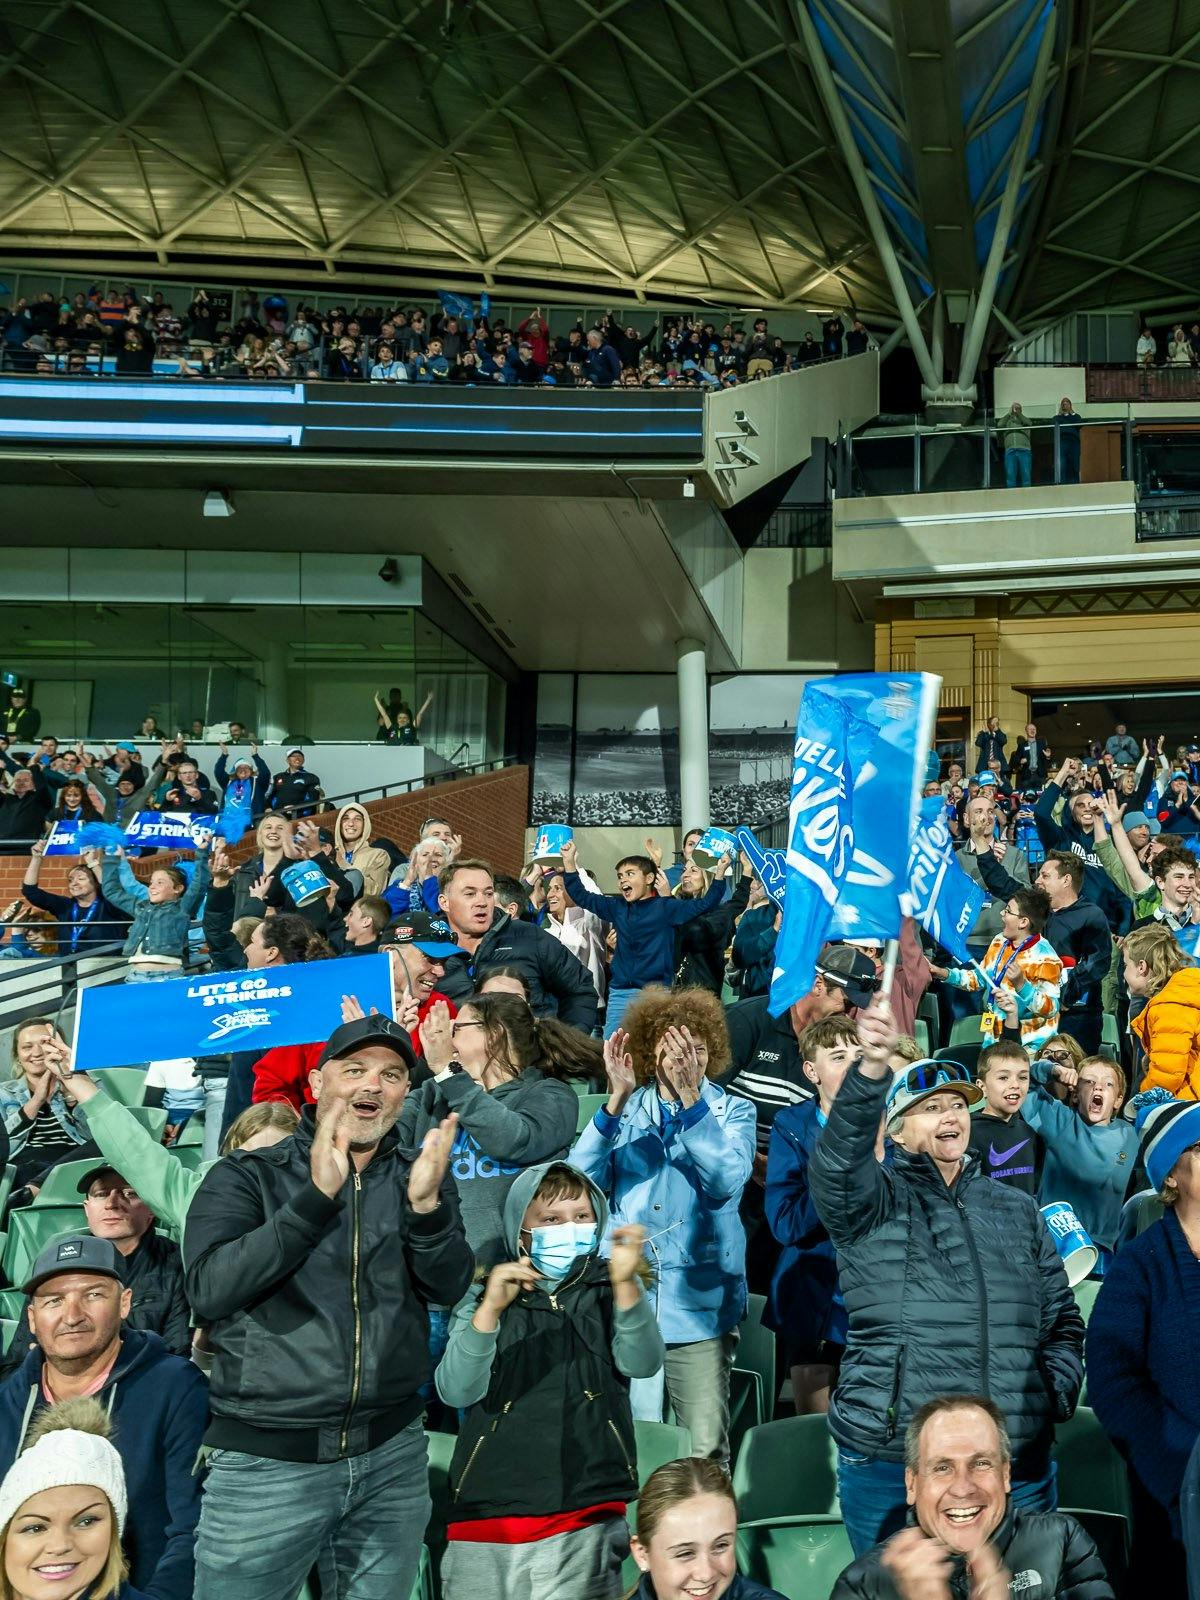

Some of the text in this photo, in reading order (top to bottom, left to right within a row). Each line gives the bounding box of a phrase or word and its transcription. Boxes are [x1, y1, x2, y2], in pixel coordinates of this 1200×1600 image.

[187, 978, 268, 998] LET'S GO
[202, 986, 292, 1007] STRIKERS
[1014, 1570, 1028, 1579] THE
[1006, 1577, 1030, 1590] NORTH
[1013, 1582, 1031, 1593] FACE
